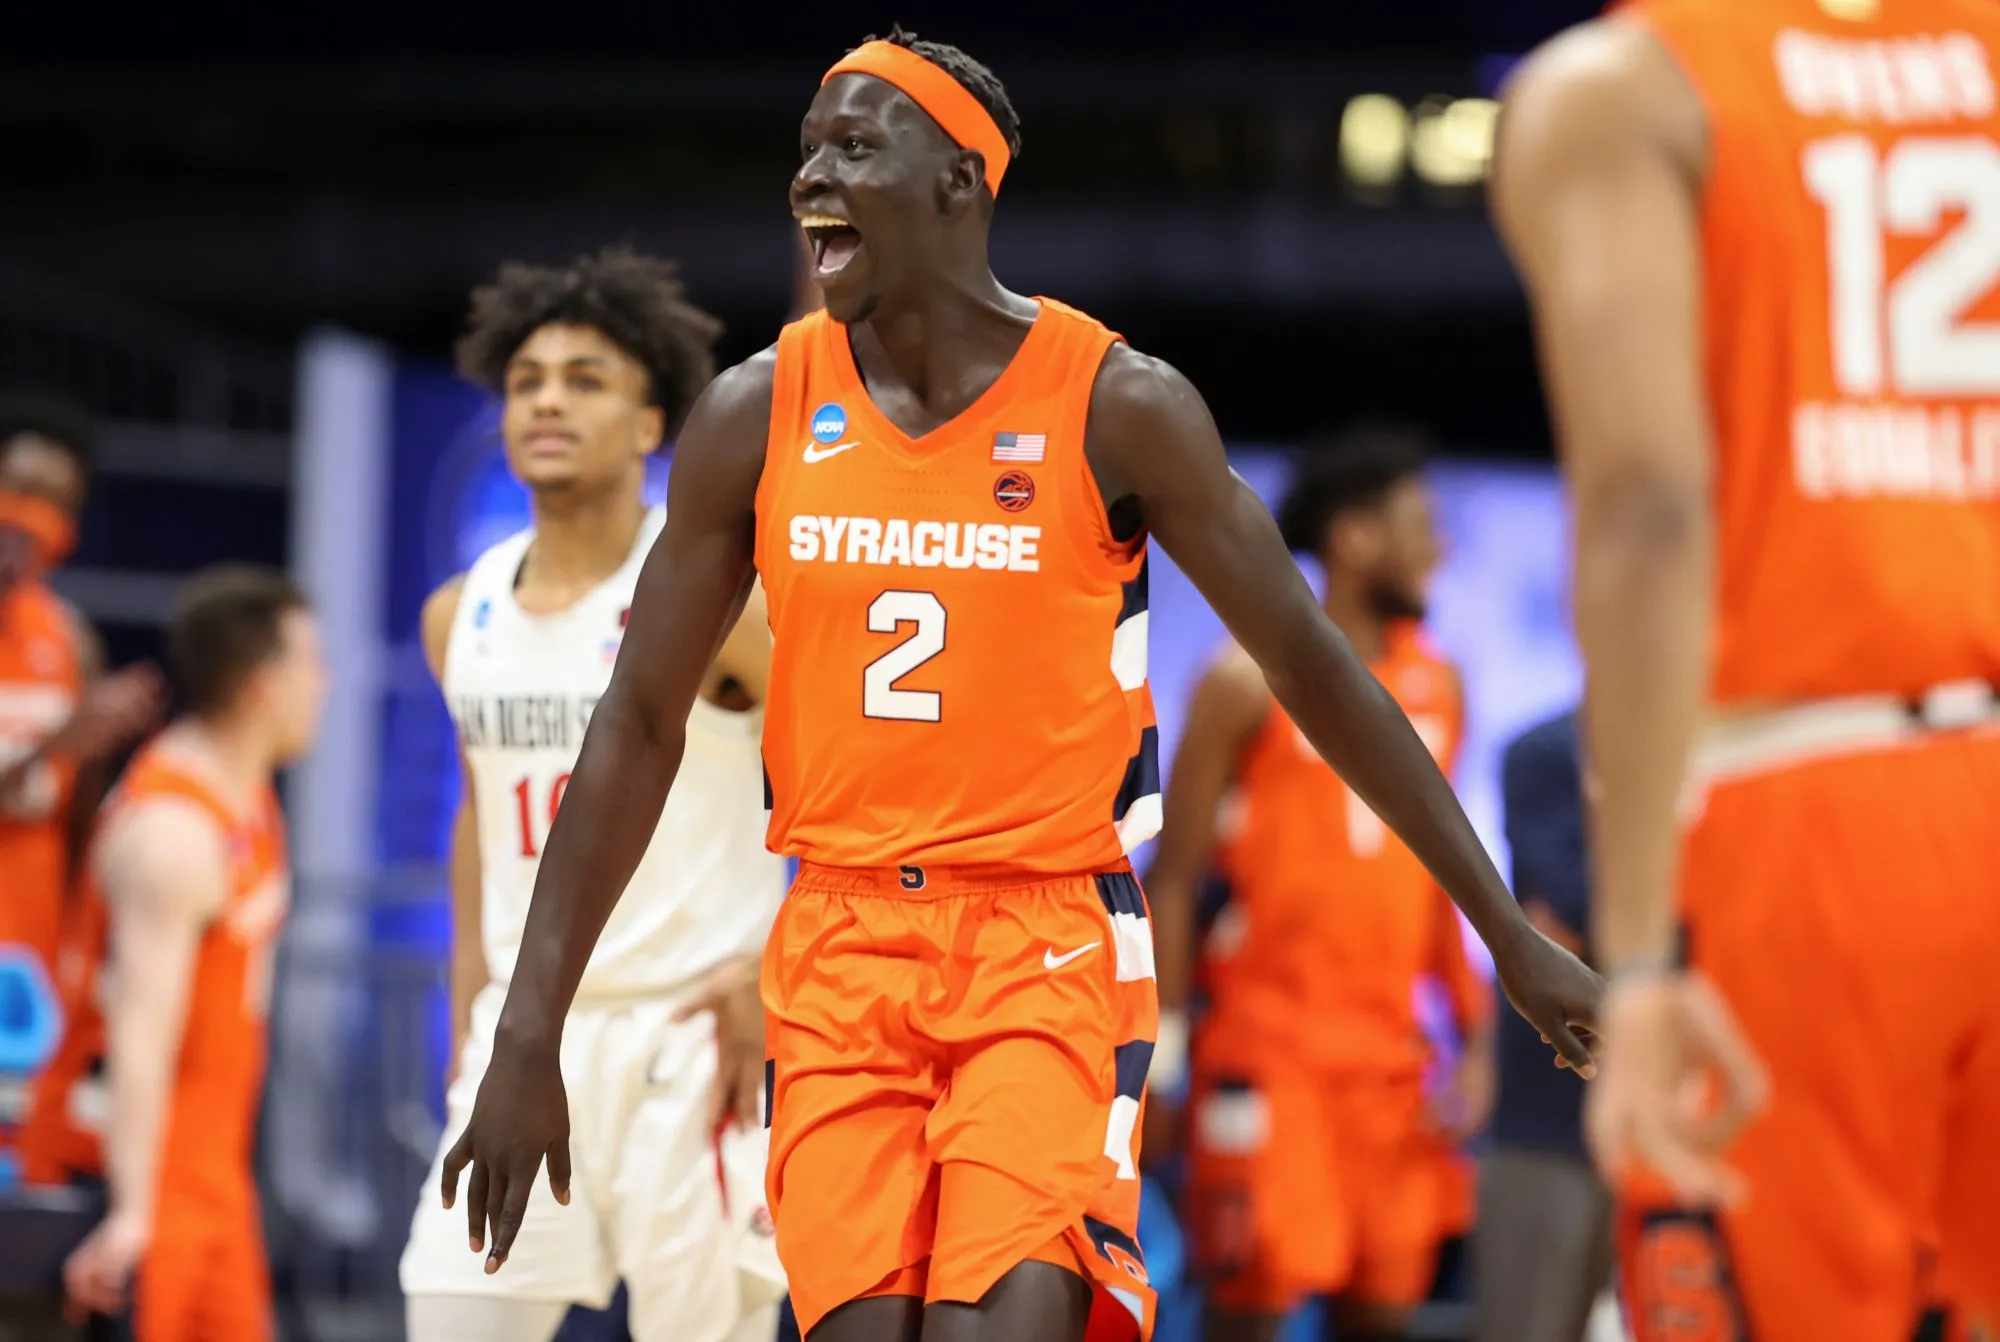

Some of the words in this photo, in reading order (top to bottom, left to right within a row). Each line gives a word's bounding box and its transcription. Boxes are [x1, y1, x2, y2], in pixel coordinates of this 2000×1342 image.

[1801, 132, 2000, 398] 12
[789, 515, 1041, 572] SYRACUSE
[863, 589, 947, 722] 2
